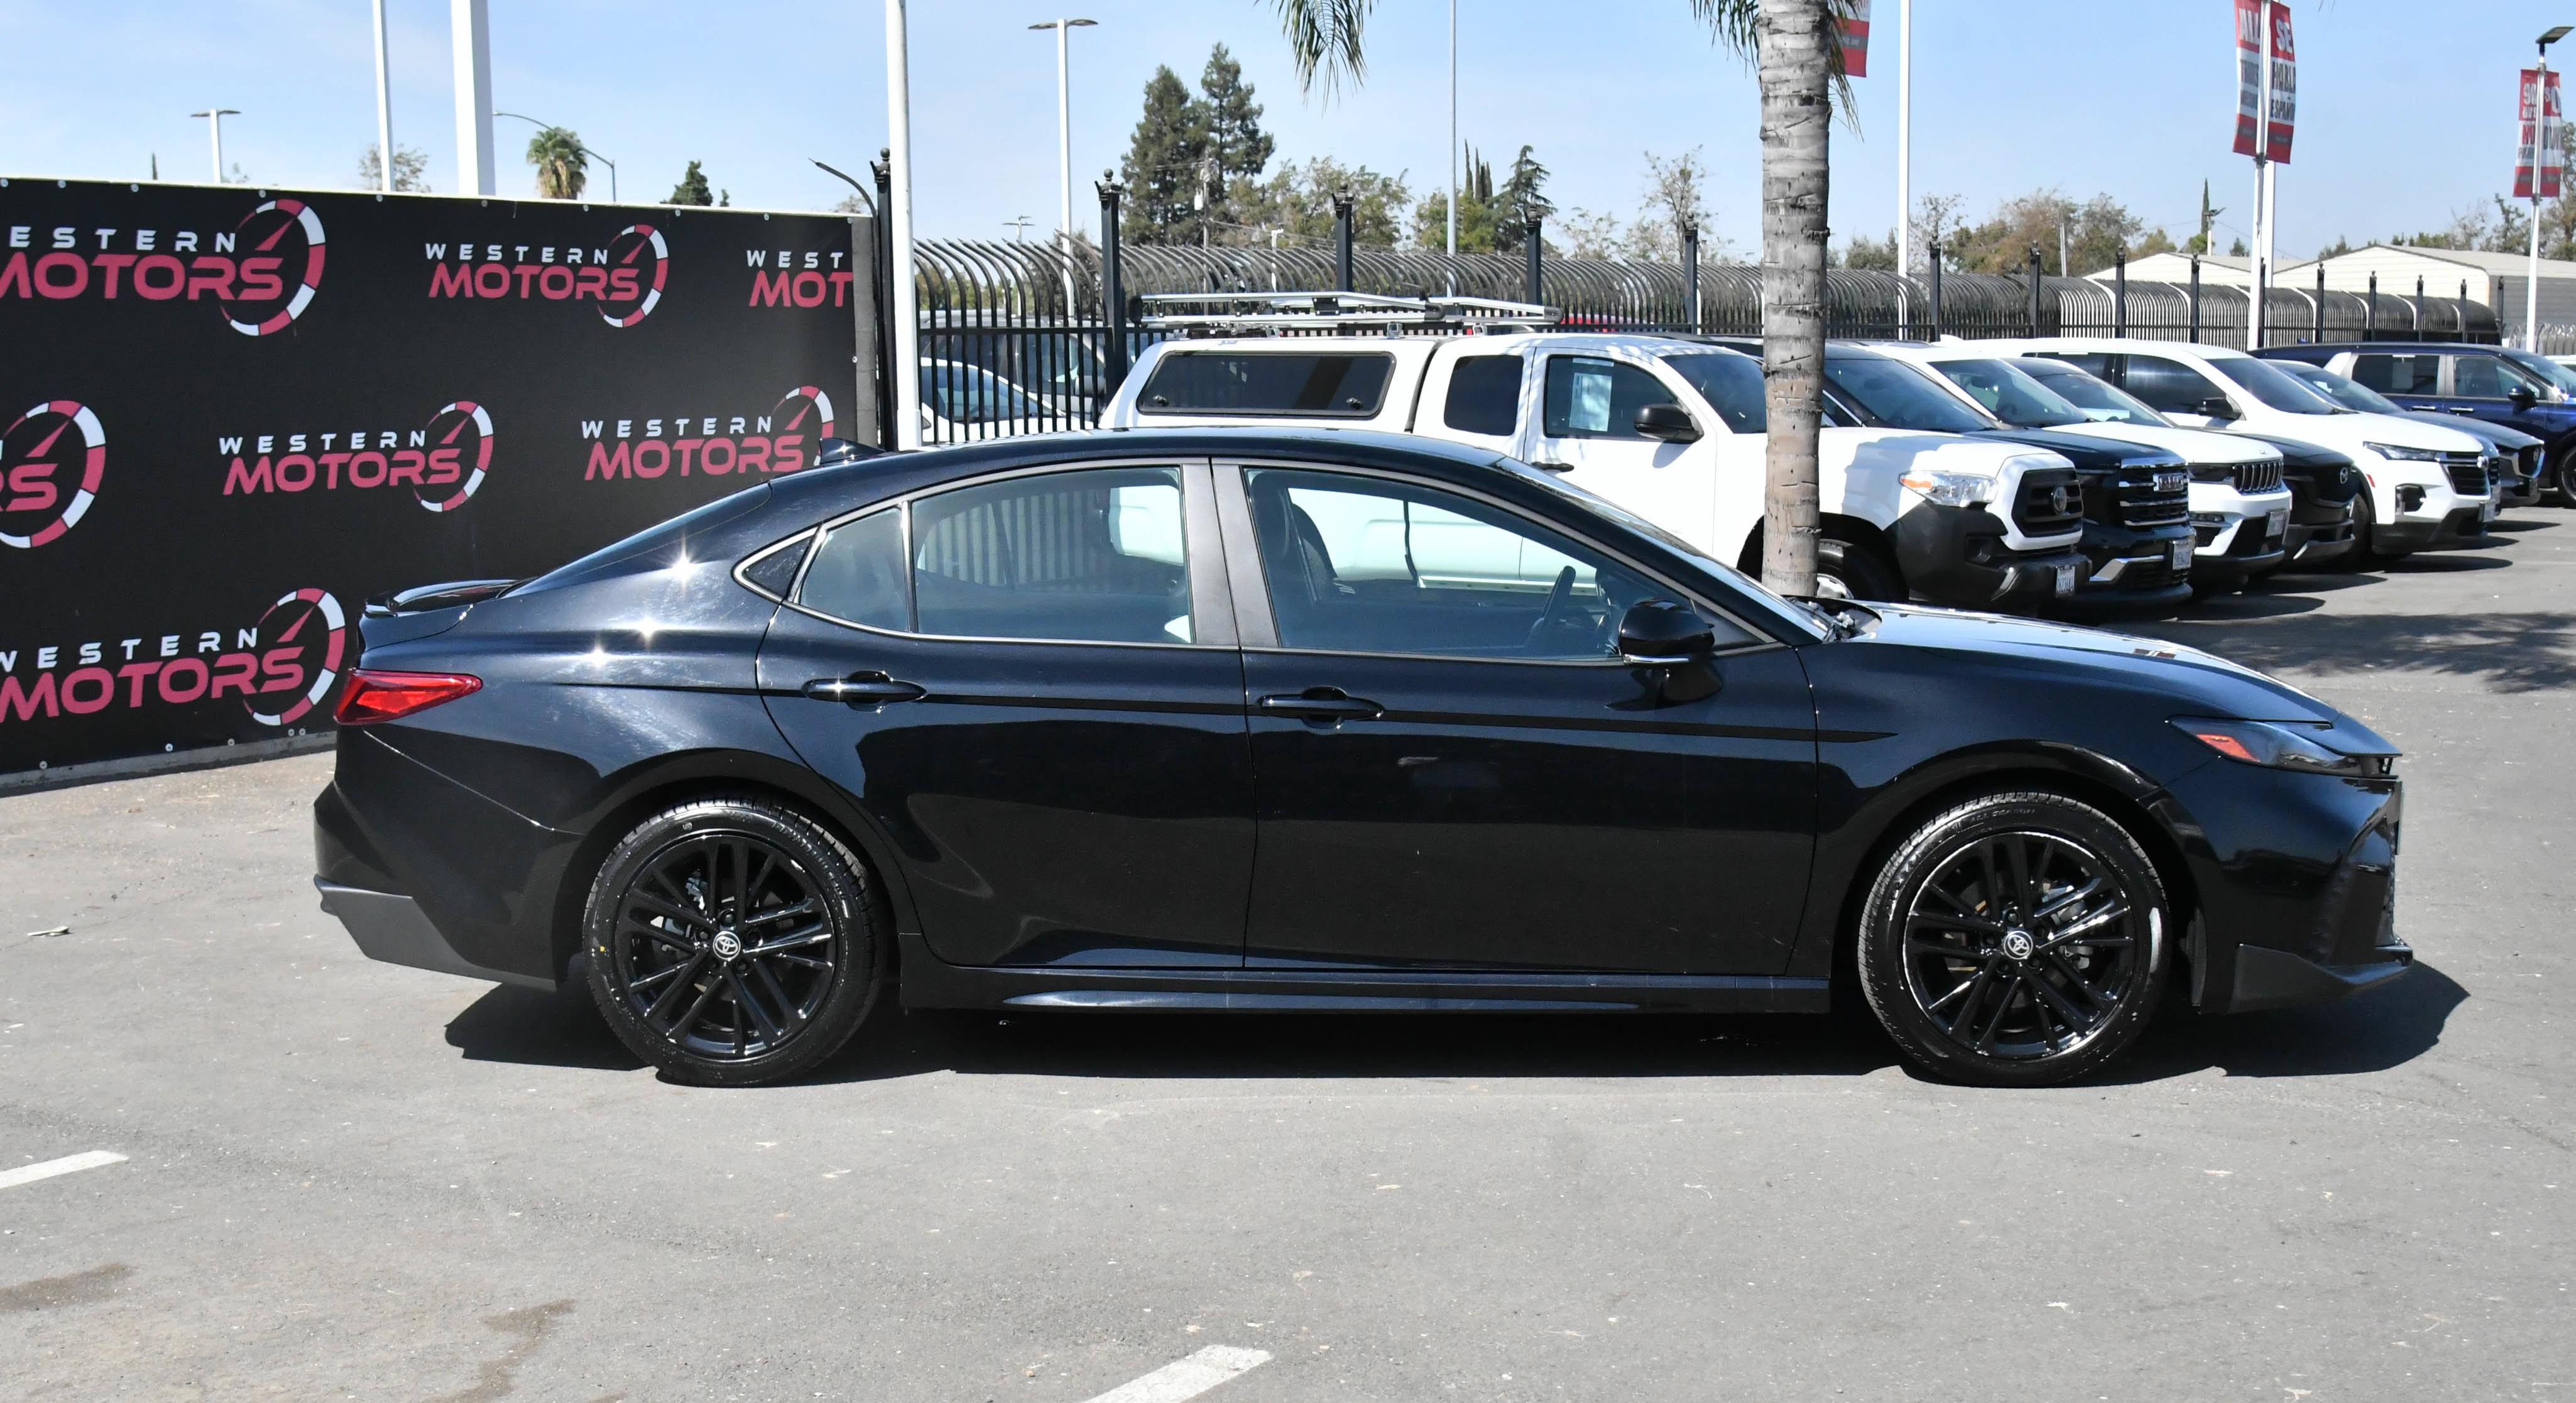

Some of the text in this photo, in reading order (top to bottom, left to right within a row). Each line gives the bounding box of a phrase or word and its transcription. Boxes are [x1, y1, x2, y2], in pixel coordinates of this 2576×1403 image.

[425, 243, 608, 265] WESTERN
[746, 249, 844, 270] WEST
[429, 263, 640, 301] MOTORS
[749, 270, 853, 308] MOT
[219, 430, 427, 455] WESTERN
[581, 415, 772, 440] WESTERN
[223, 448, 461, 495] MOTORS
[584, 435, 804, 481] MOTORS
[0, 646, 305, 724] MOTORS
